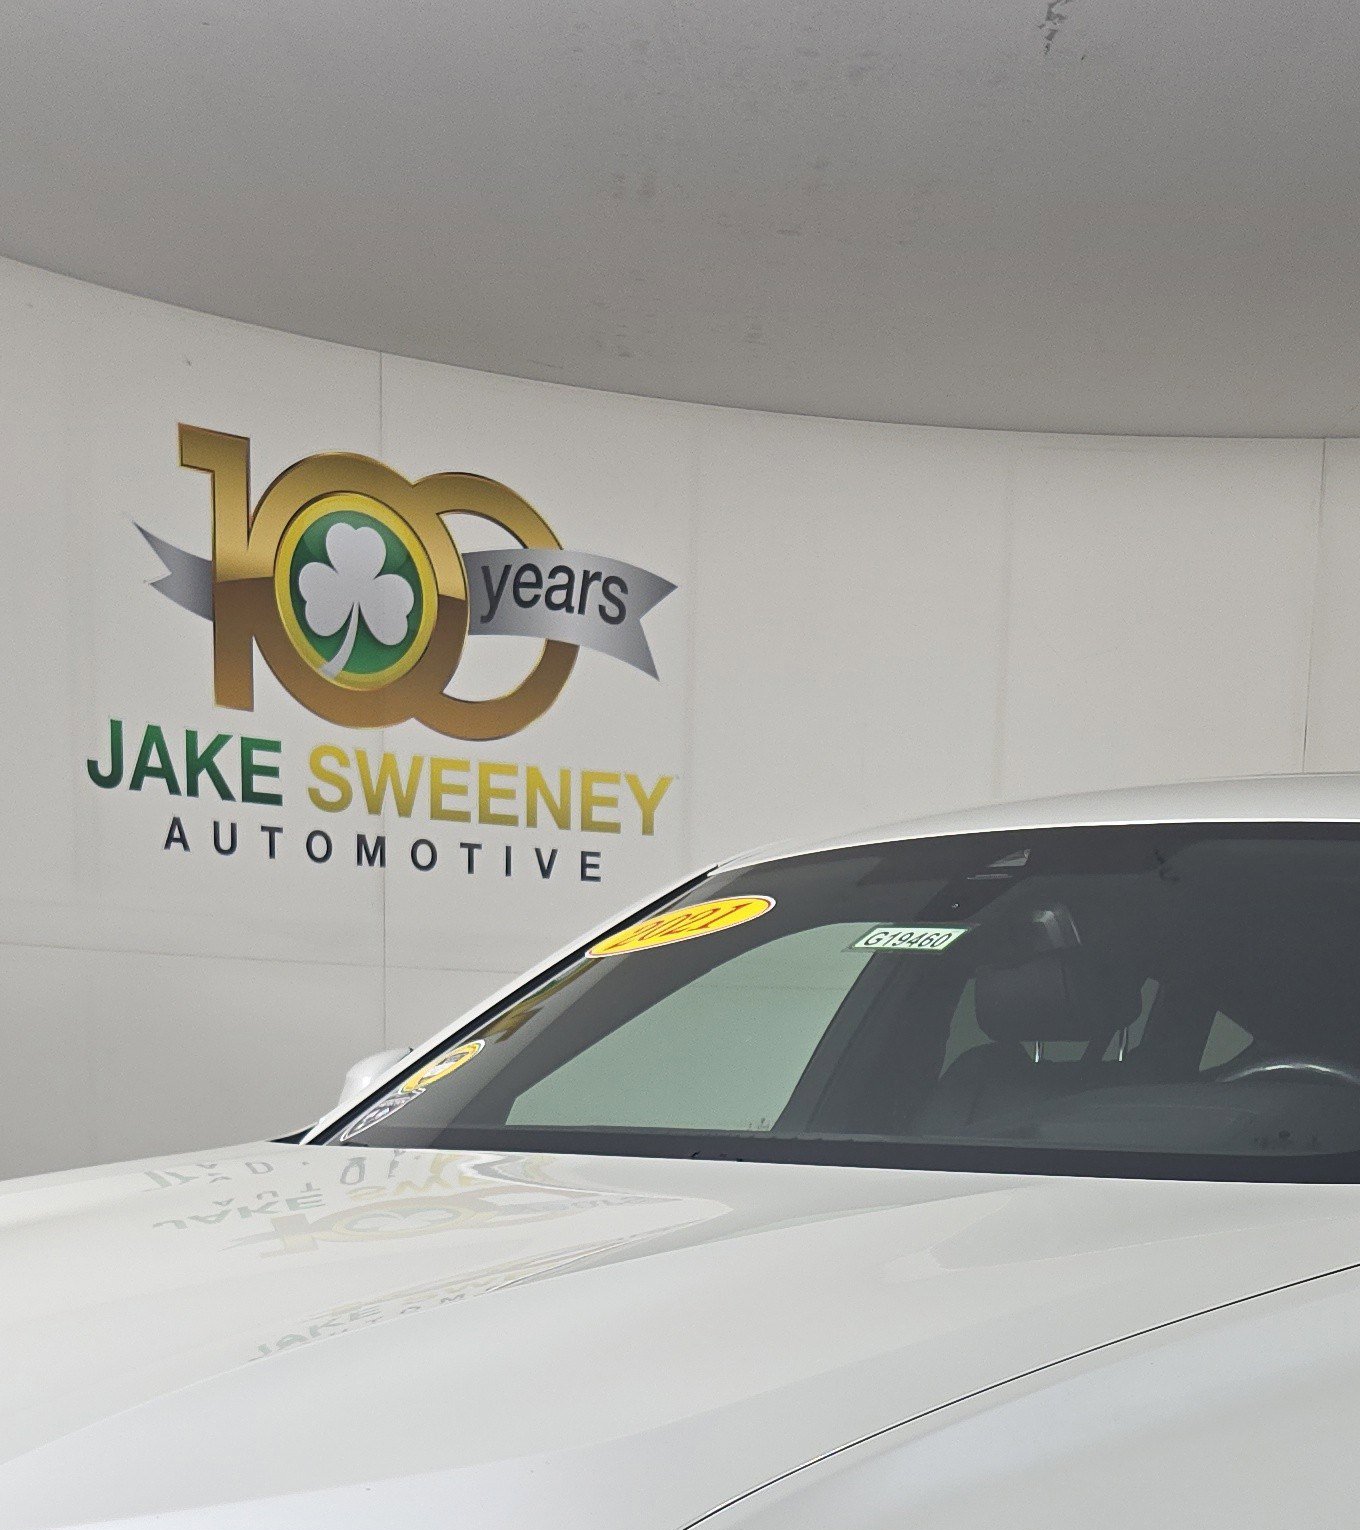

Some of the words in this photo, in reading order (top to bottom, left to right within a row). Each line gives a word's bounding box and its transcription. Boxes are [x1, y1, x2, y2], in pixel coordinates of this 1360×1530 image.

[177, 422, 580, 741] 100
[479, 552, 629, 625] years
[86, 719, 283, 806] JAKE
[306, 745, 674, 836] SWEENEY
[163, 816, 602, 883] AUTOMOTIVE
[604, 902, 753, 952] 2021
[863, 931, 953, 948] G19460
